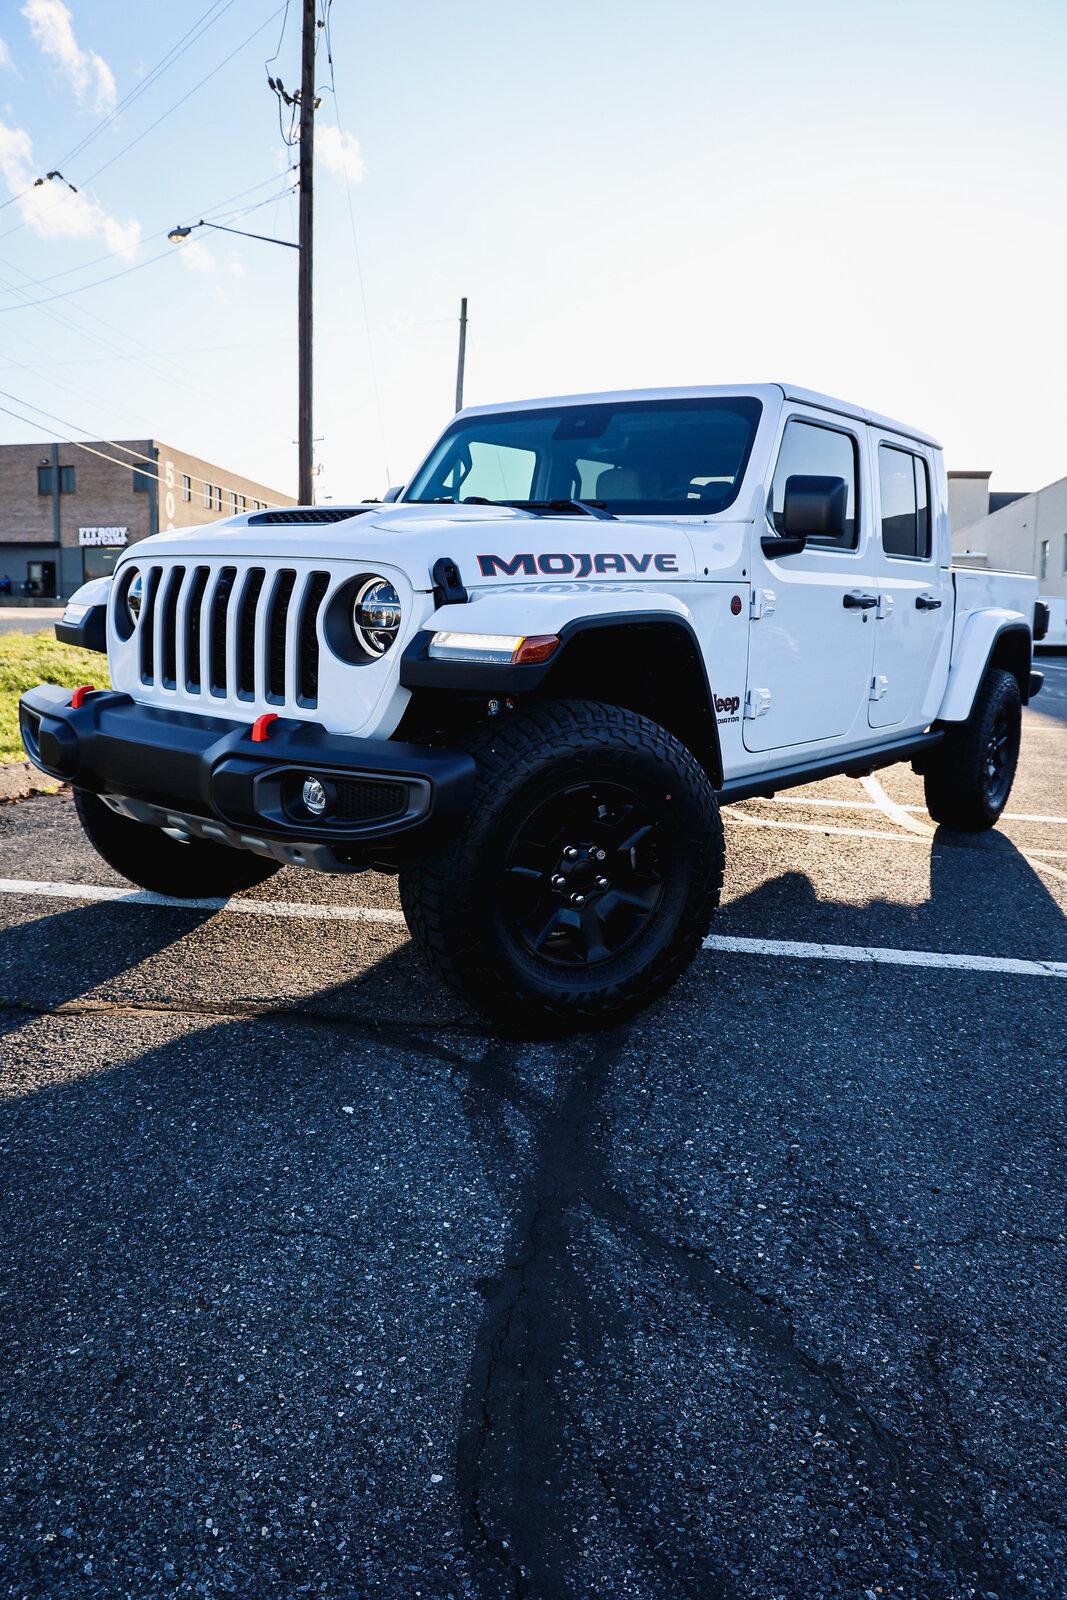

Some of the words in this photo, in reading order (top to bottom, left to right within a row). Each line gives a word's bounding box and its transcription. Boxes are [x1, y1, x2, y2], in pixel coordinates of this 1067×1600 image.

[165, 460, 176, 531] 50
[78, 527, 98, 538] FIT
[98, 526, 128, 538] BODY
[476, 553, 679, 578] MOJAVE
[717, 716, 740, 724] DIATOR
